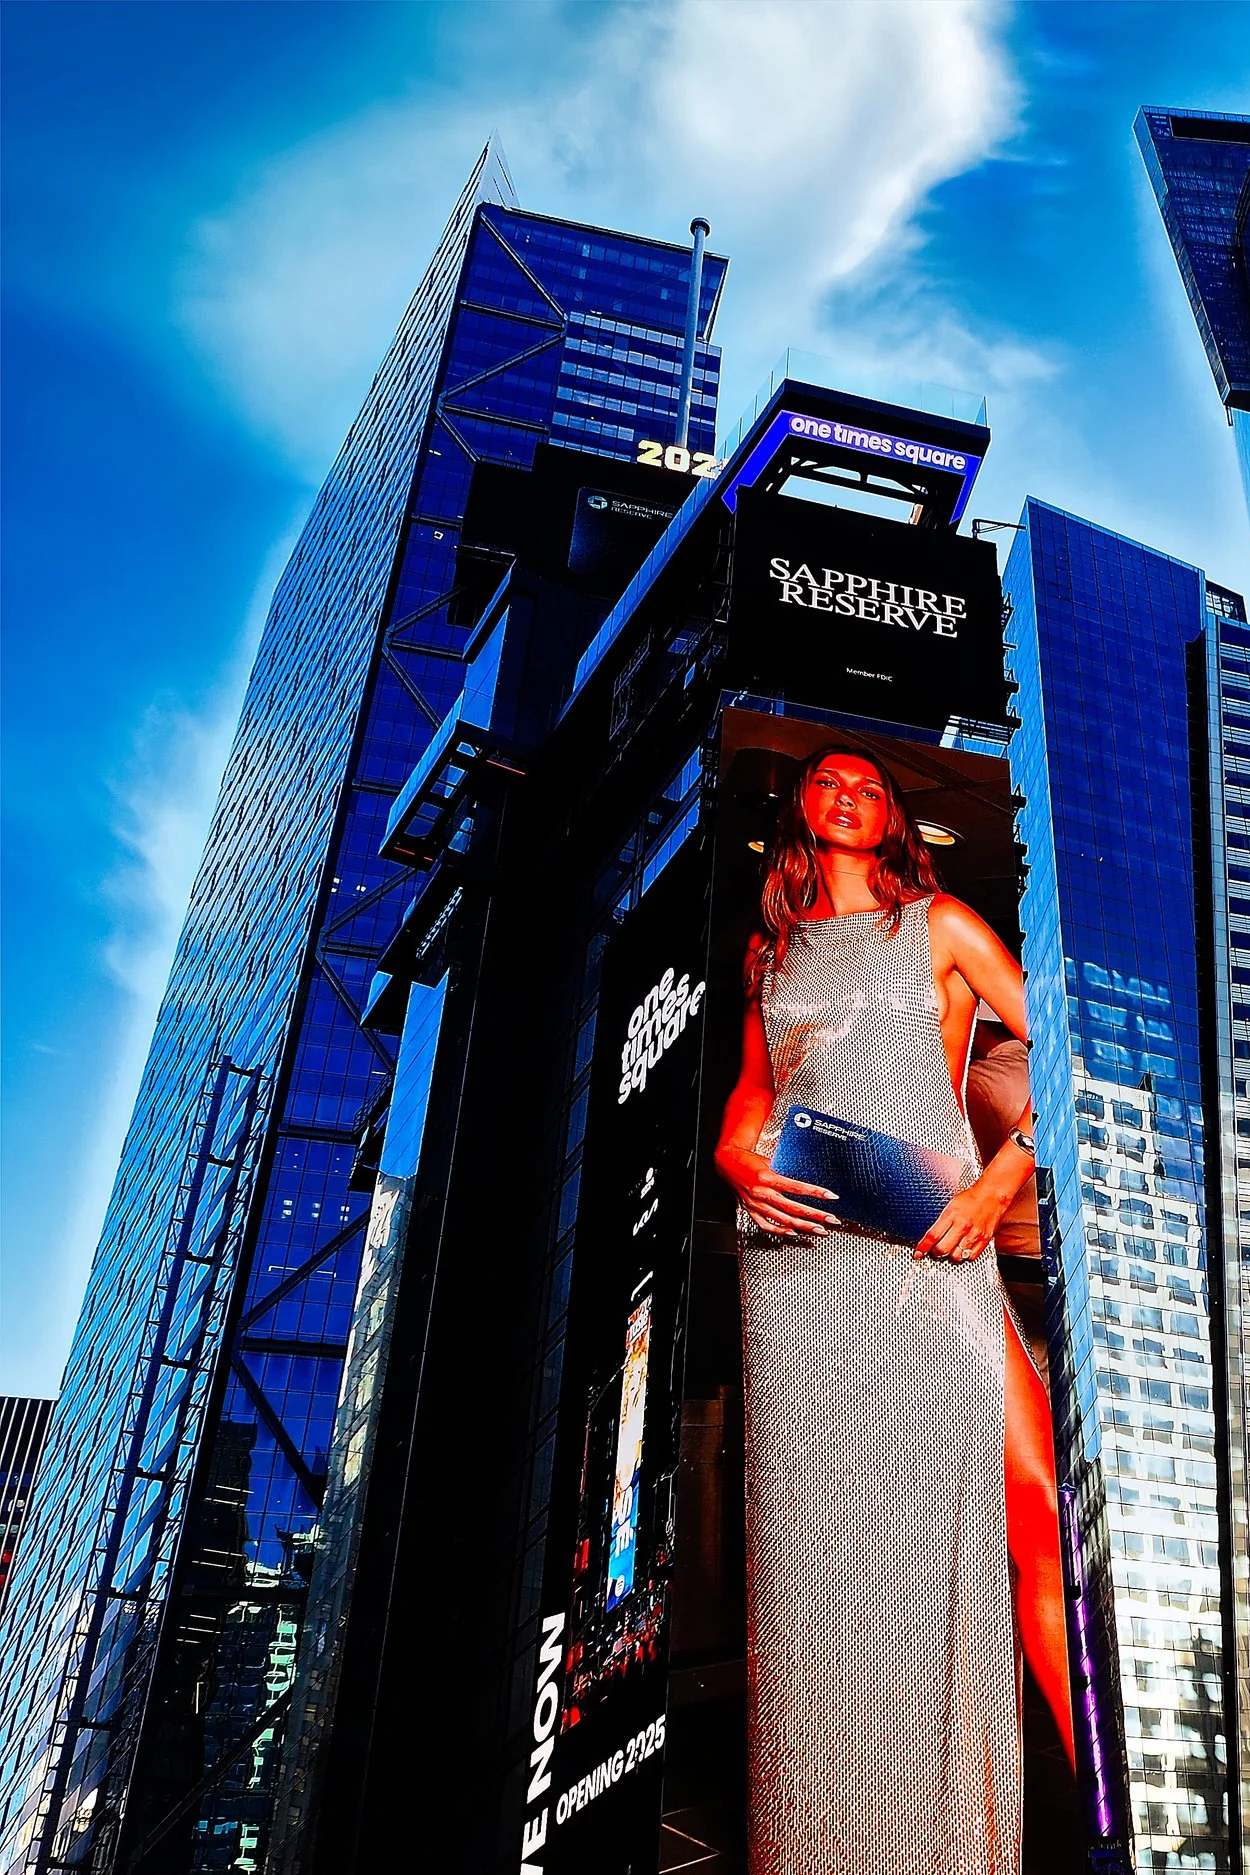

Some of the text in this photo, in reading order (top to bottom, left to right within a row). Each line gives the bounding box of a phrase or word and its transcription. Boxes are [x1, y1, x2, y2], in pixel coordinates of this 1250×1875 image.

[636, 439, 729, 480] 202
[790, 417, 967, 466] one times square
[611, 500, 674, 519] SAPPHIRE
[769, 557, 968, 619] SAPPHIRE
[778, 580, 958, 639] RESERVE
[846, 667, 893, 682] Member FDIC
[621, 973, 690, 1074] times
[628, 967, 675, 1039] one
[618, 981, 706, 1105] square
[812, 1125, 848, 1142] RESERVE
[814, 1119, 867, 1141] SAPPHIRE
[526, 1611, 566, 1805] NOW
[555, 1713, 667, 1825] OPENING 2025
